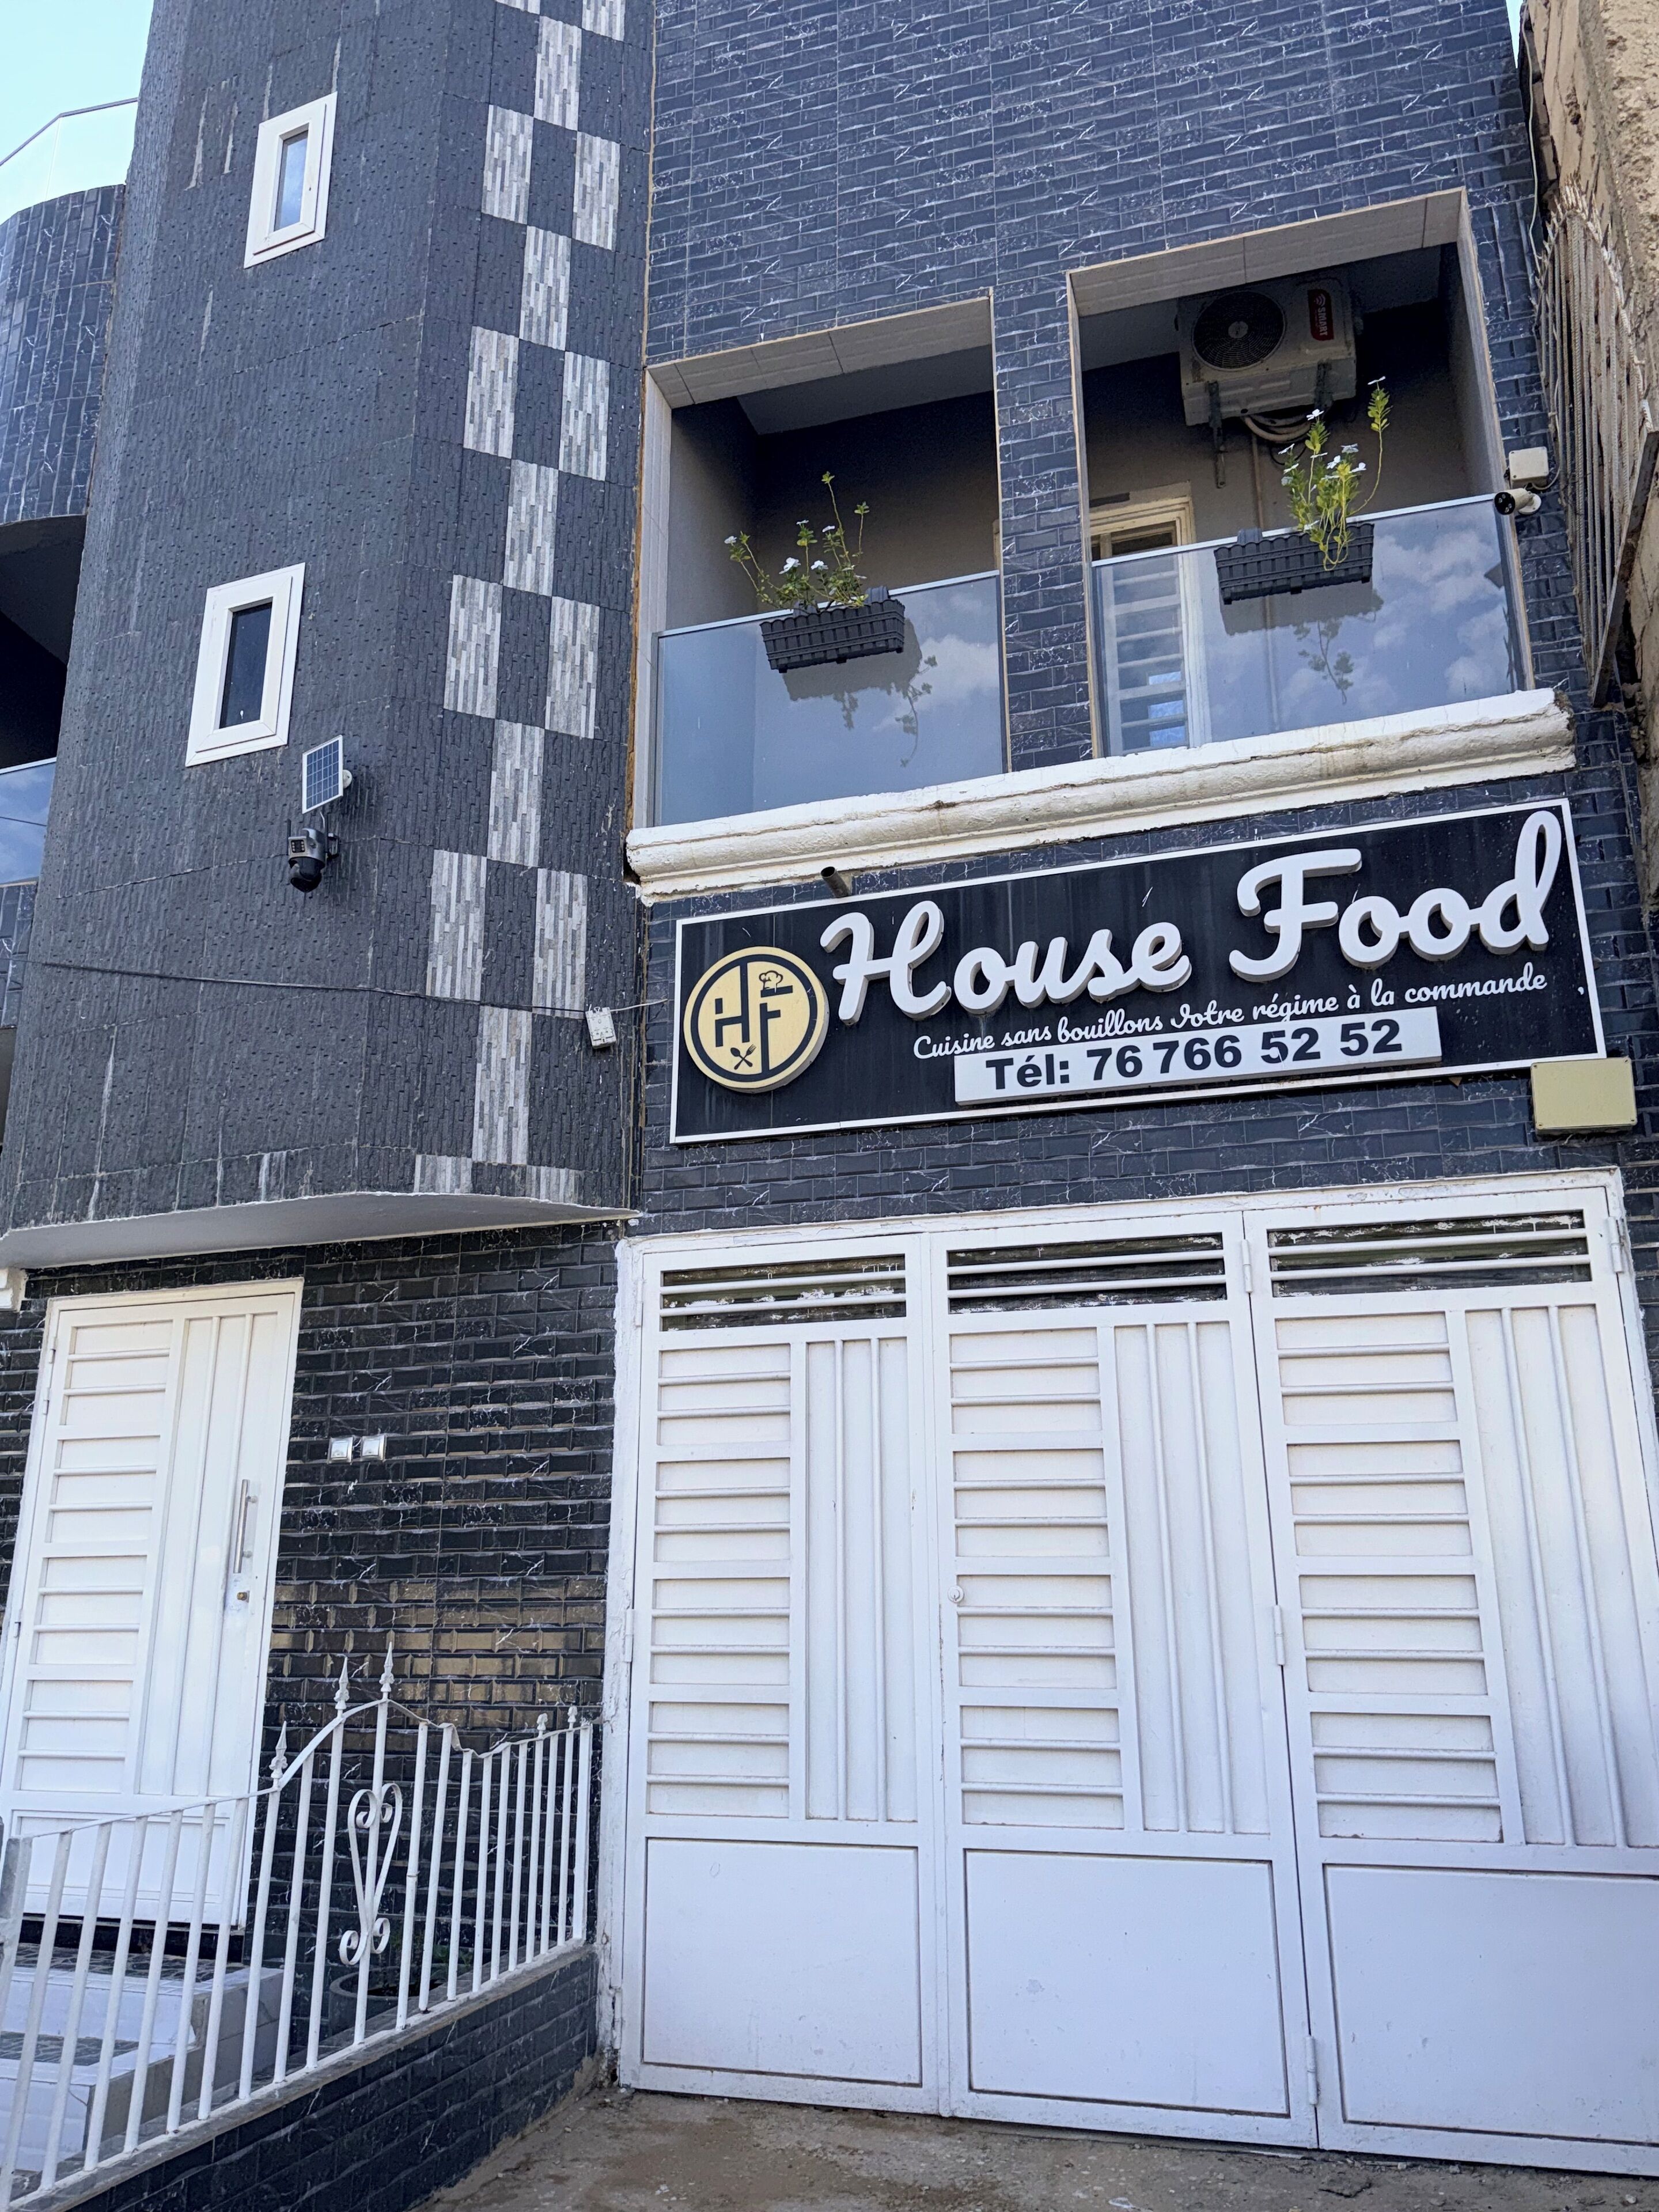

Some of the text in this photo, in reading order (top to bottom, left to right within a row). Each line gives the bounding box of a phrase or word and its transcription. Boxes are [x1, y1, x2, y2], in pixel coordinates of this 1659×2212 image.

[1317, 306, 1328, 336] SMART
[820, 810, 1562, 1025] House Food
[913, 1033, 995, 1059] Cuisine
[1001, 1025, 1052, 1047] sans
[1057, 1008, 1163, 1044] bouillons
[1252, 993, 1339, 1023] régime
[1347, 984, 1361, 1009] à
[1370, 978, 1395, 1006] la
[1404, 961, 1548, 1003] commande
[986, 1018, 1402, 1090] Tél: 76 766 52 52
